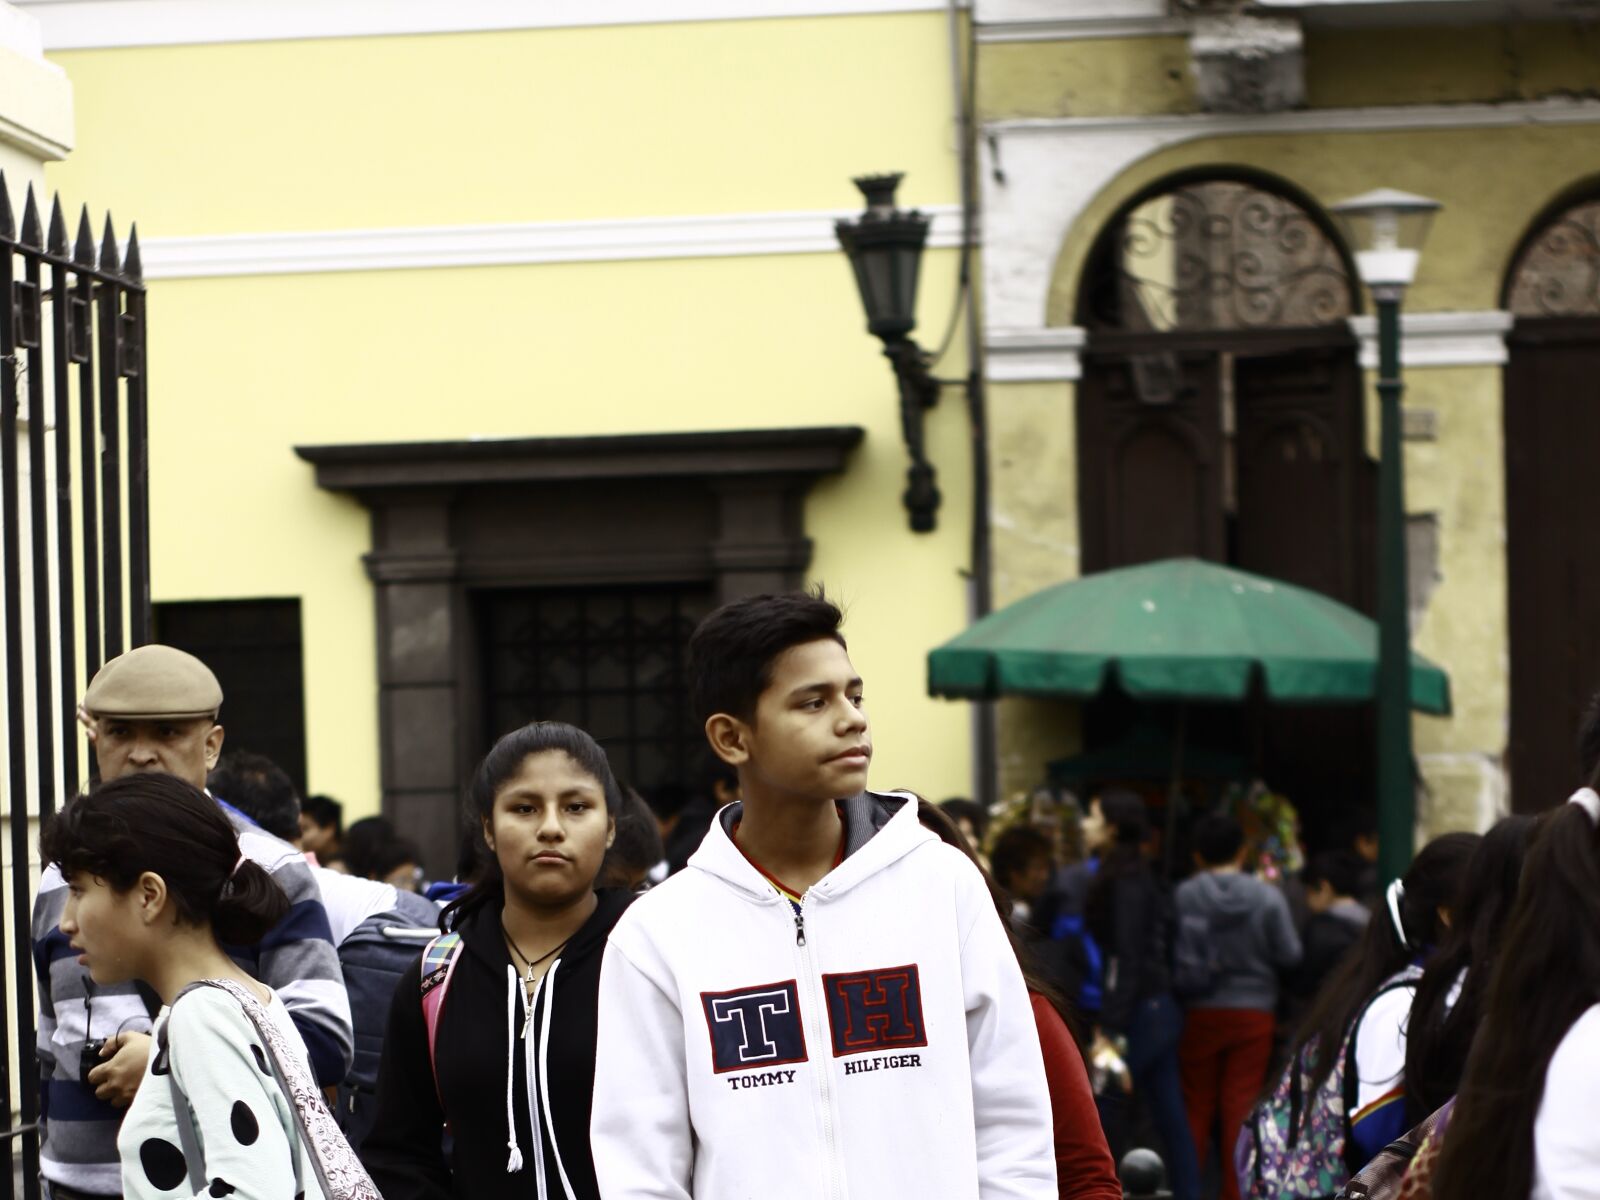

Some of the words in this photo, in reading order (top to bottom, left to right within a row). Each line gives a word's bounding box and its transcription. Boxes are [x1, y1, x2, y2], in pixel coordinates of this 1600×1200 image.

[711, 989, 790, 1061] T
[837, 973, 915, 1046] H
[727, 1070, 797, 1090] TOMMY
[844, 1055, 922, 1075] HILFIGER
